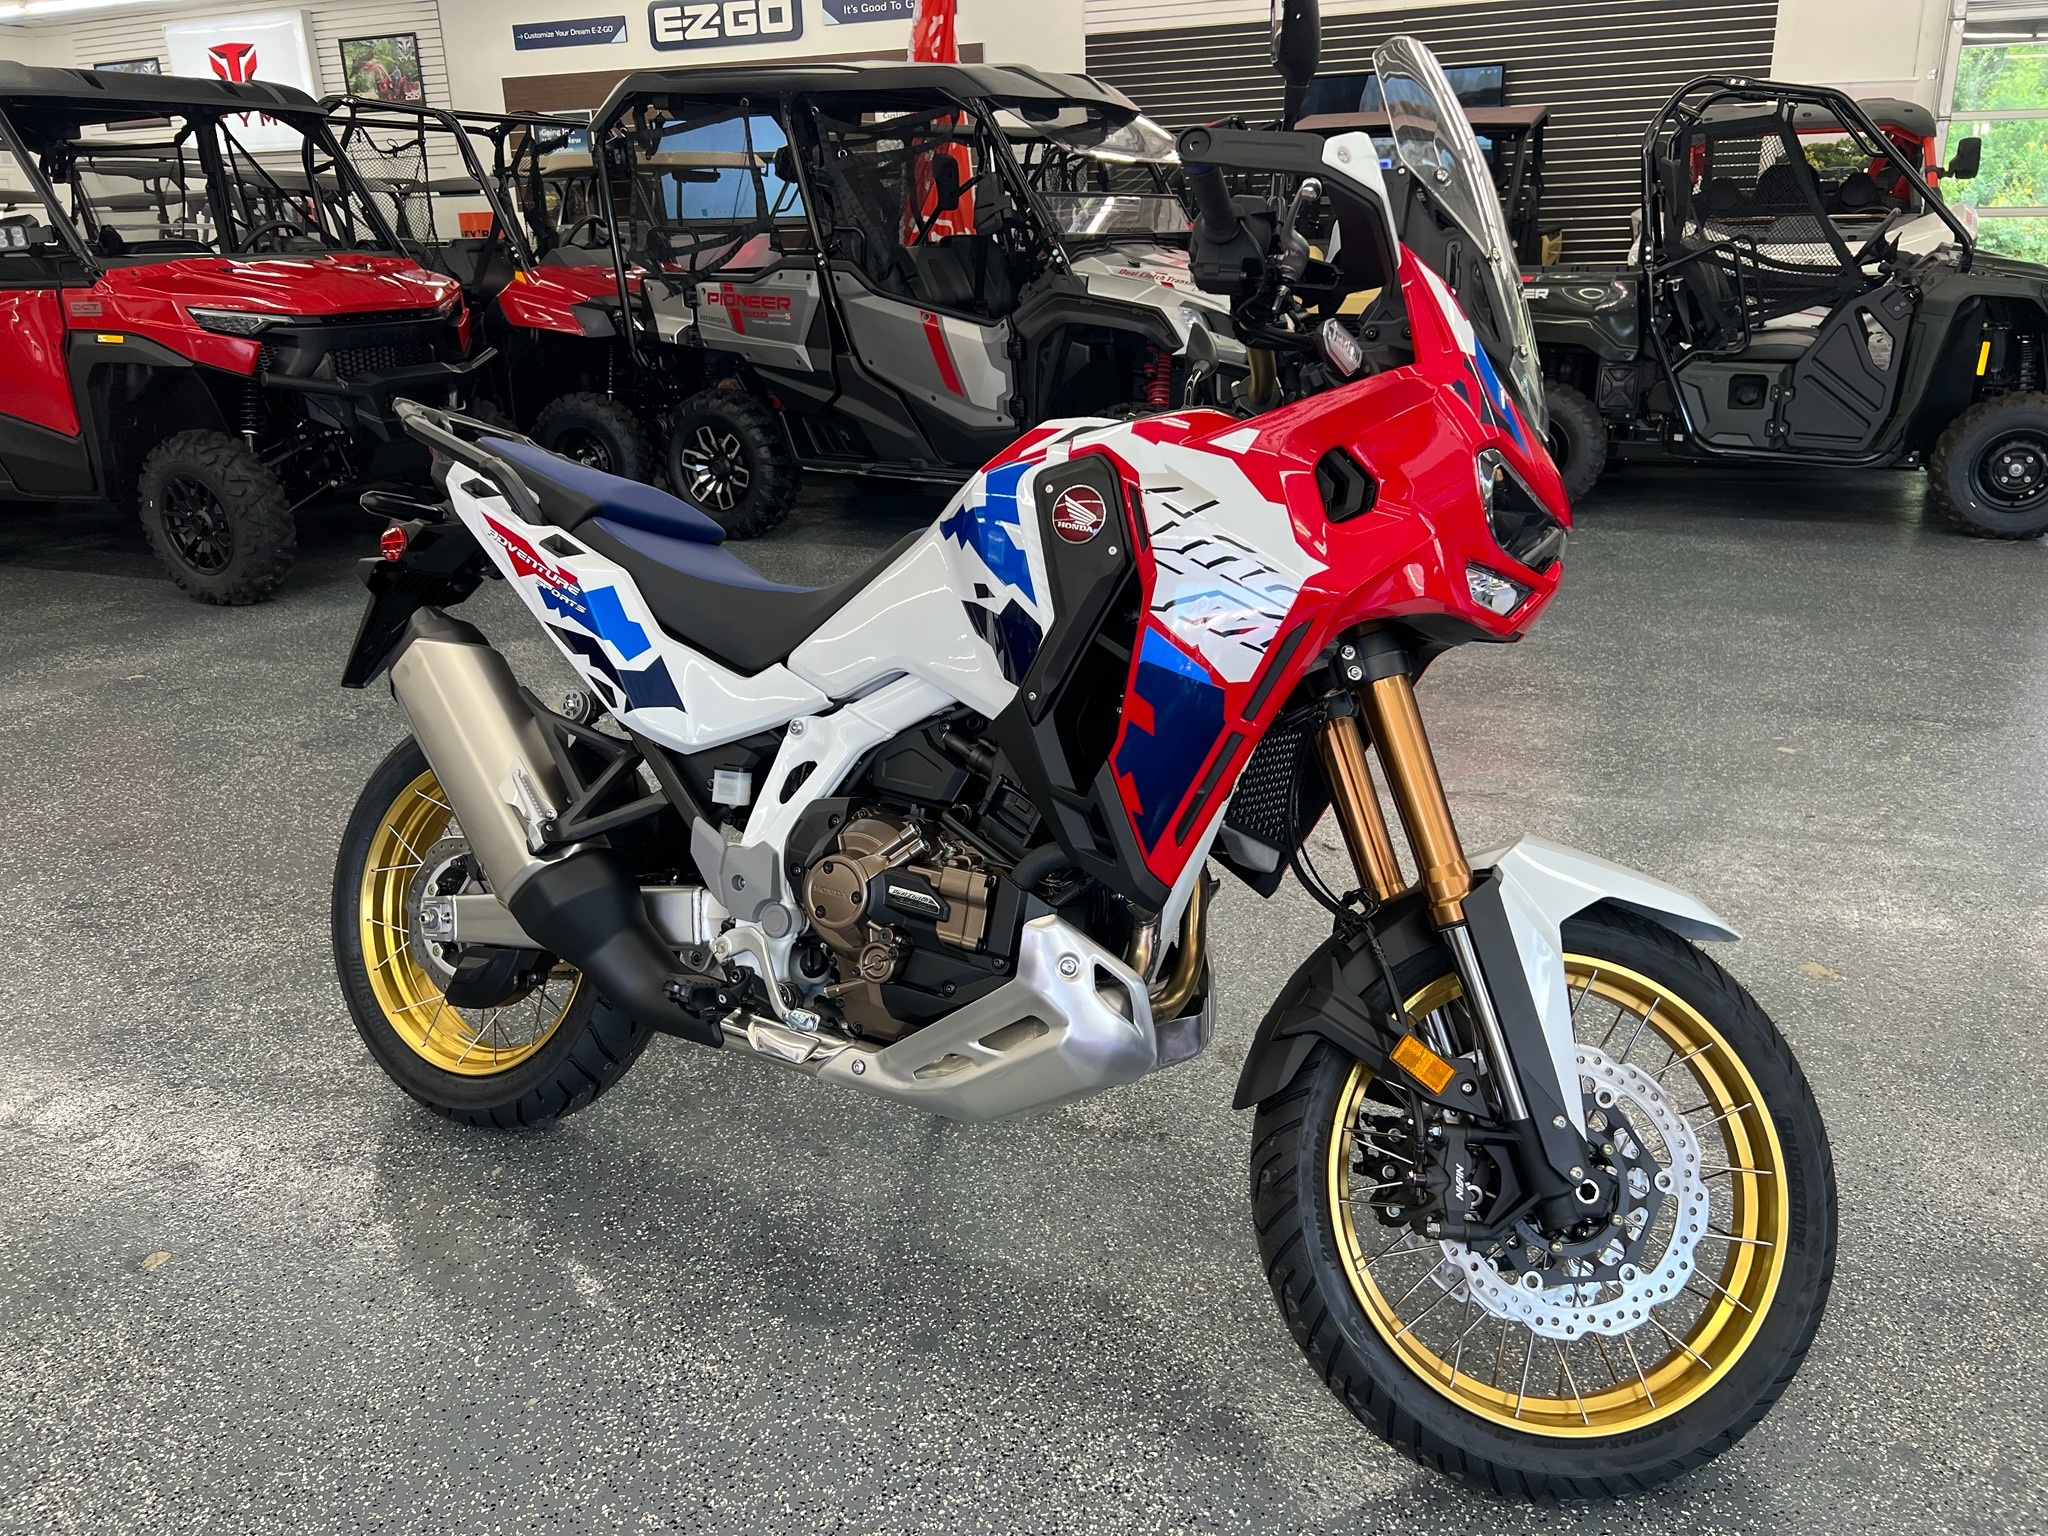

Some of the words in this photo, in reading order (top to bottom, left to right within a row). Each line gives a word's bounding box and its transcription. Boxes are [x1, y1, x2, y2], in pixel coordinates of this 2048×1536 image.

[843, 4, 859, 15] It's
[860, 1, 887, 13] Good
[889, 0, 902, 10] To
[523, 31, 555, 40] Customize
[554, 29, 569, 38] Your
[570, 27, 591, 36] Dream
[541, 129, 562, 137] Going
[1118, 268, 1140, 277] Dual
[1140, 271, 1166, 281] Clutch
[71, 303, 99, 311] DCT
[707, 292, 792, 311] PIONEER
[699, 314, 727, 325] HONDA
[1057, 521, 1095, 534] HONDA
[487, 528, 581, 597] ADVENTURE
[535, 578, 587, 614] SPORTS
[1777, 1114, 1807, 1251] BRIDGESTONE
